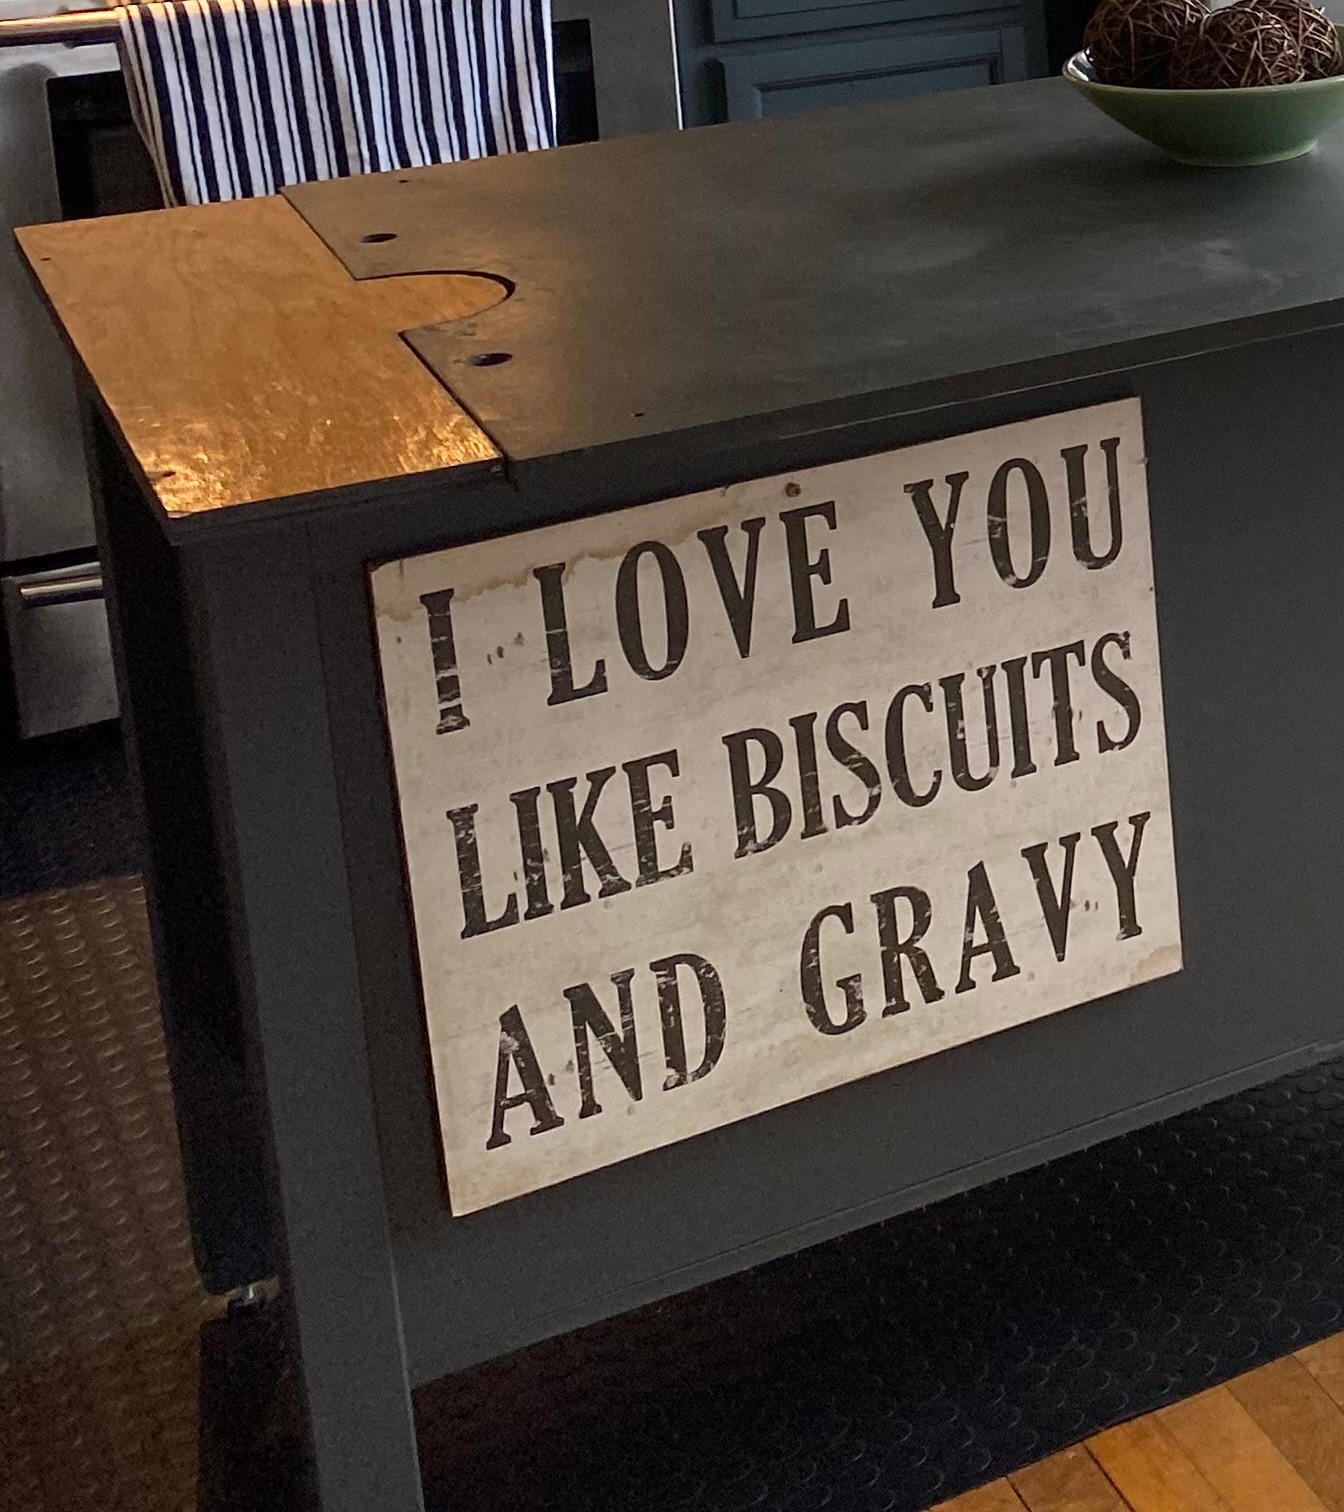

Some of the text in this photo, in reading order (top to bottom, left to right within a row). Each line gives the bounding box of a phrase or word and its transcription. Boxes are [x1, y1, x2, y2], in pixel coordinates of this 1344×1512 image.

[420, 437, 1123, 735] I LOVE YOU
[446, 630, 1143, 940] LIKE BISCUITS
[485, 811, 1152, 1151] AND GRAVY
